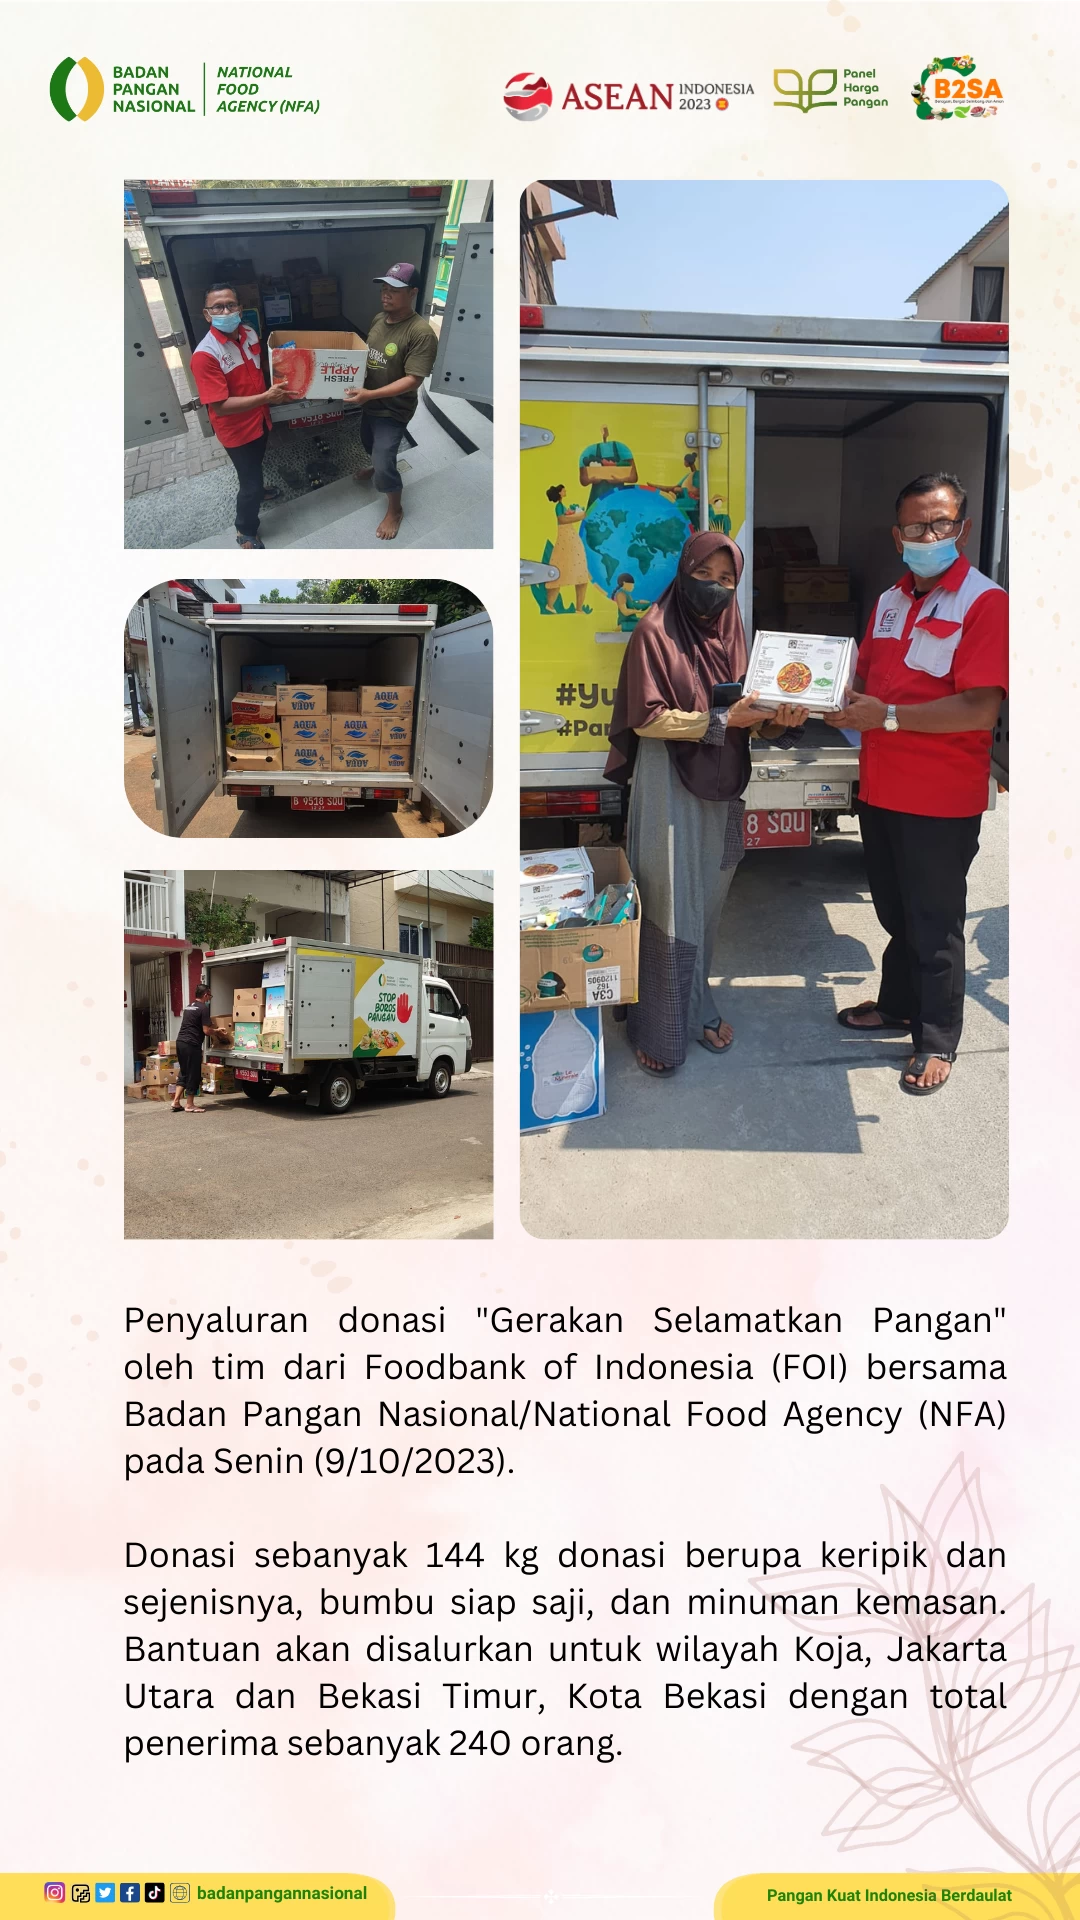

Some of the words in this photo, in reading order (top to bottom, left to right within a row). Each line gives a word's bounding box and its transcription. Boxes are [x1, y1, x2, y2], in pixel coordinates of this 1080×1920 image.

[320, 365, 359, 375] APPLE
[324, 375, 355, 383] FRESH
[374, 691, 399, 702] AQUA
[291, 700, 315, 711] AQUA
[293, 720, 317, 730] AQUA
[344, 720, 368, 730] AQUA
[294, 749, 318, 758] AQUA
[345, 758, 368, 768] AQUA
[293, 797, 299, 806] B
[303, 797, 324, 806] 9518
[327, 797, 343, 806] SQU
[767, 811, 805, 834] SQU
[747, 837, 761, 846] 27
[588, 974, 618, 984] 1120905
[596, 982, 609, 990] 162
[378, 992, 396, 1002] STOP
[592, 989, 614, 1001] C3A
[375, 1002, 396, 1012] BOROS
[367, 1012, 396, 1022] PANGAN
